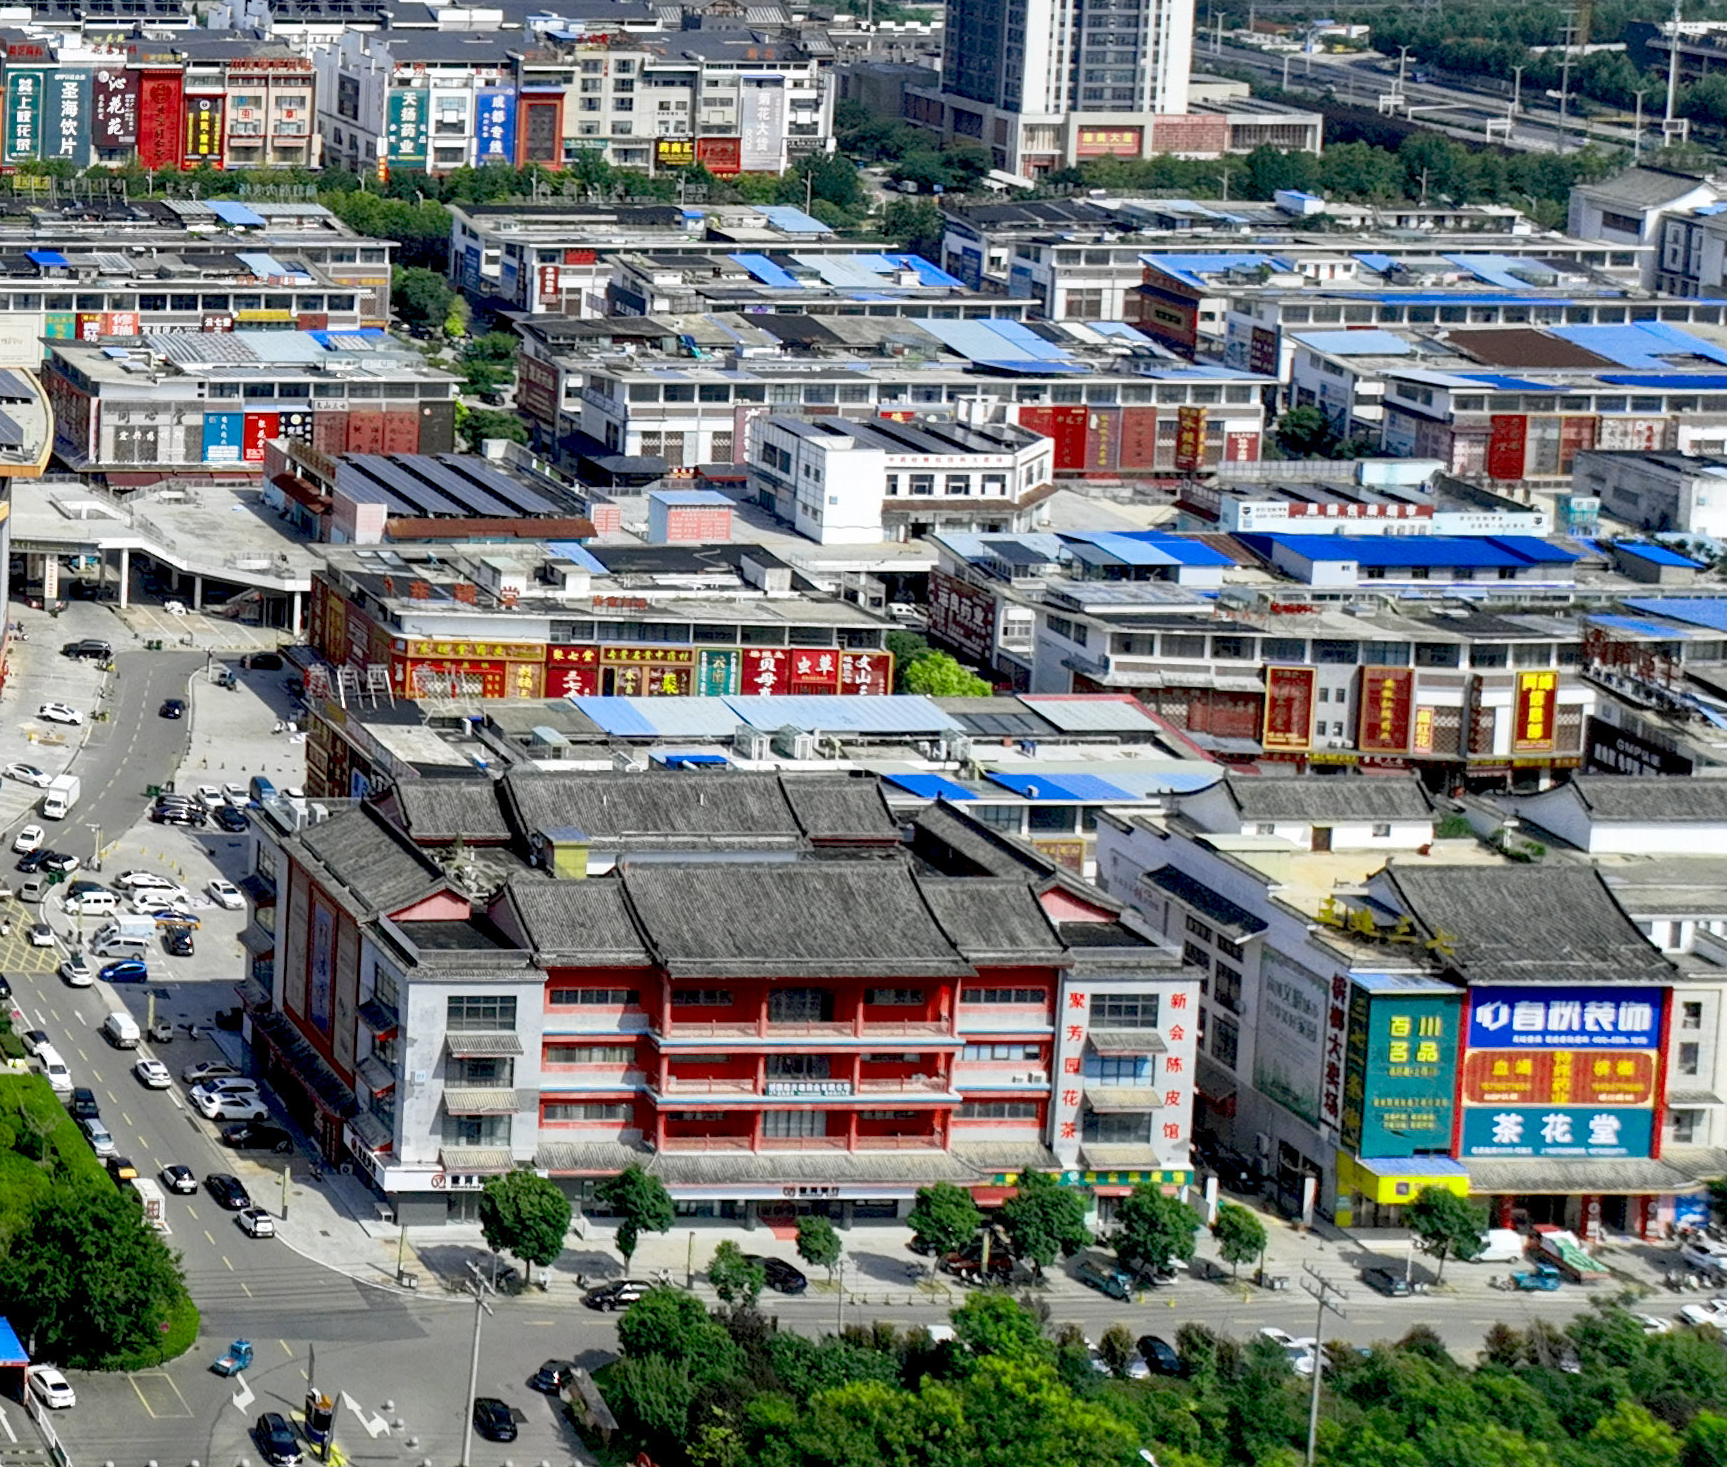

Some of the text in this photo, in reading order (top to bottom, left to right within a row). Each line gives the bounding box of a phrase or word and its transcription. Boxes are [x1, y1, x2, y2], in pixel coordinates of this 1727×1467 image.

[59, 81, 80, 155] 圣海饮片
[796, 650, 835, 674] 虫草
[1060, 992, 1086, 1140] 聚芳园花茶
[1162, 993, 1188, 1140] 新会陈皮馆
[1491, 1112, 1622, 1146] 茶花堂
